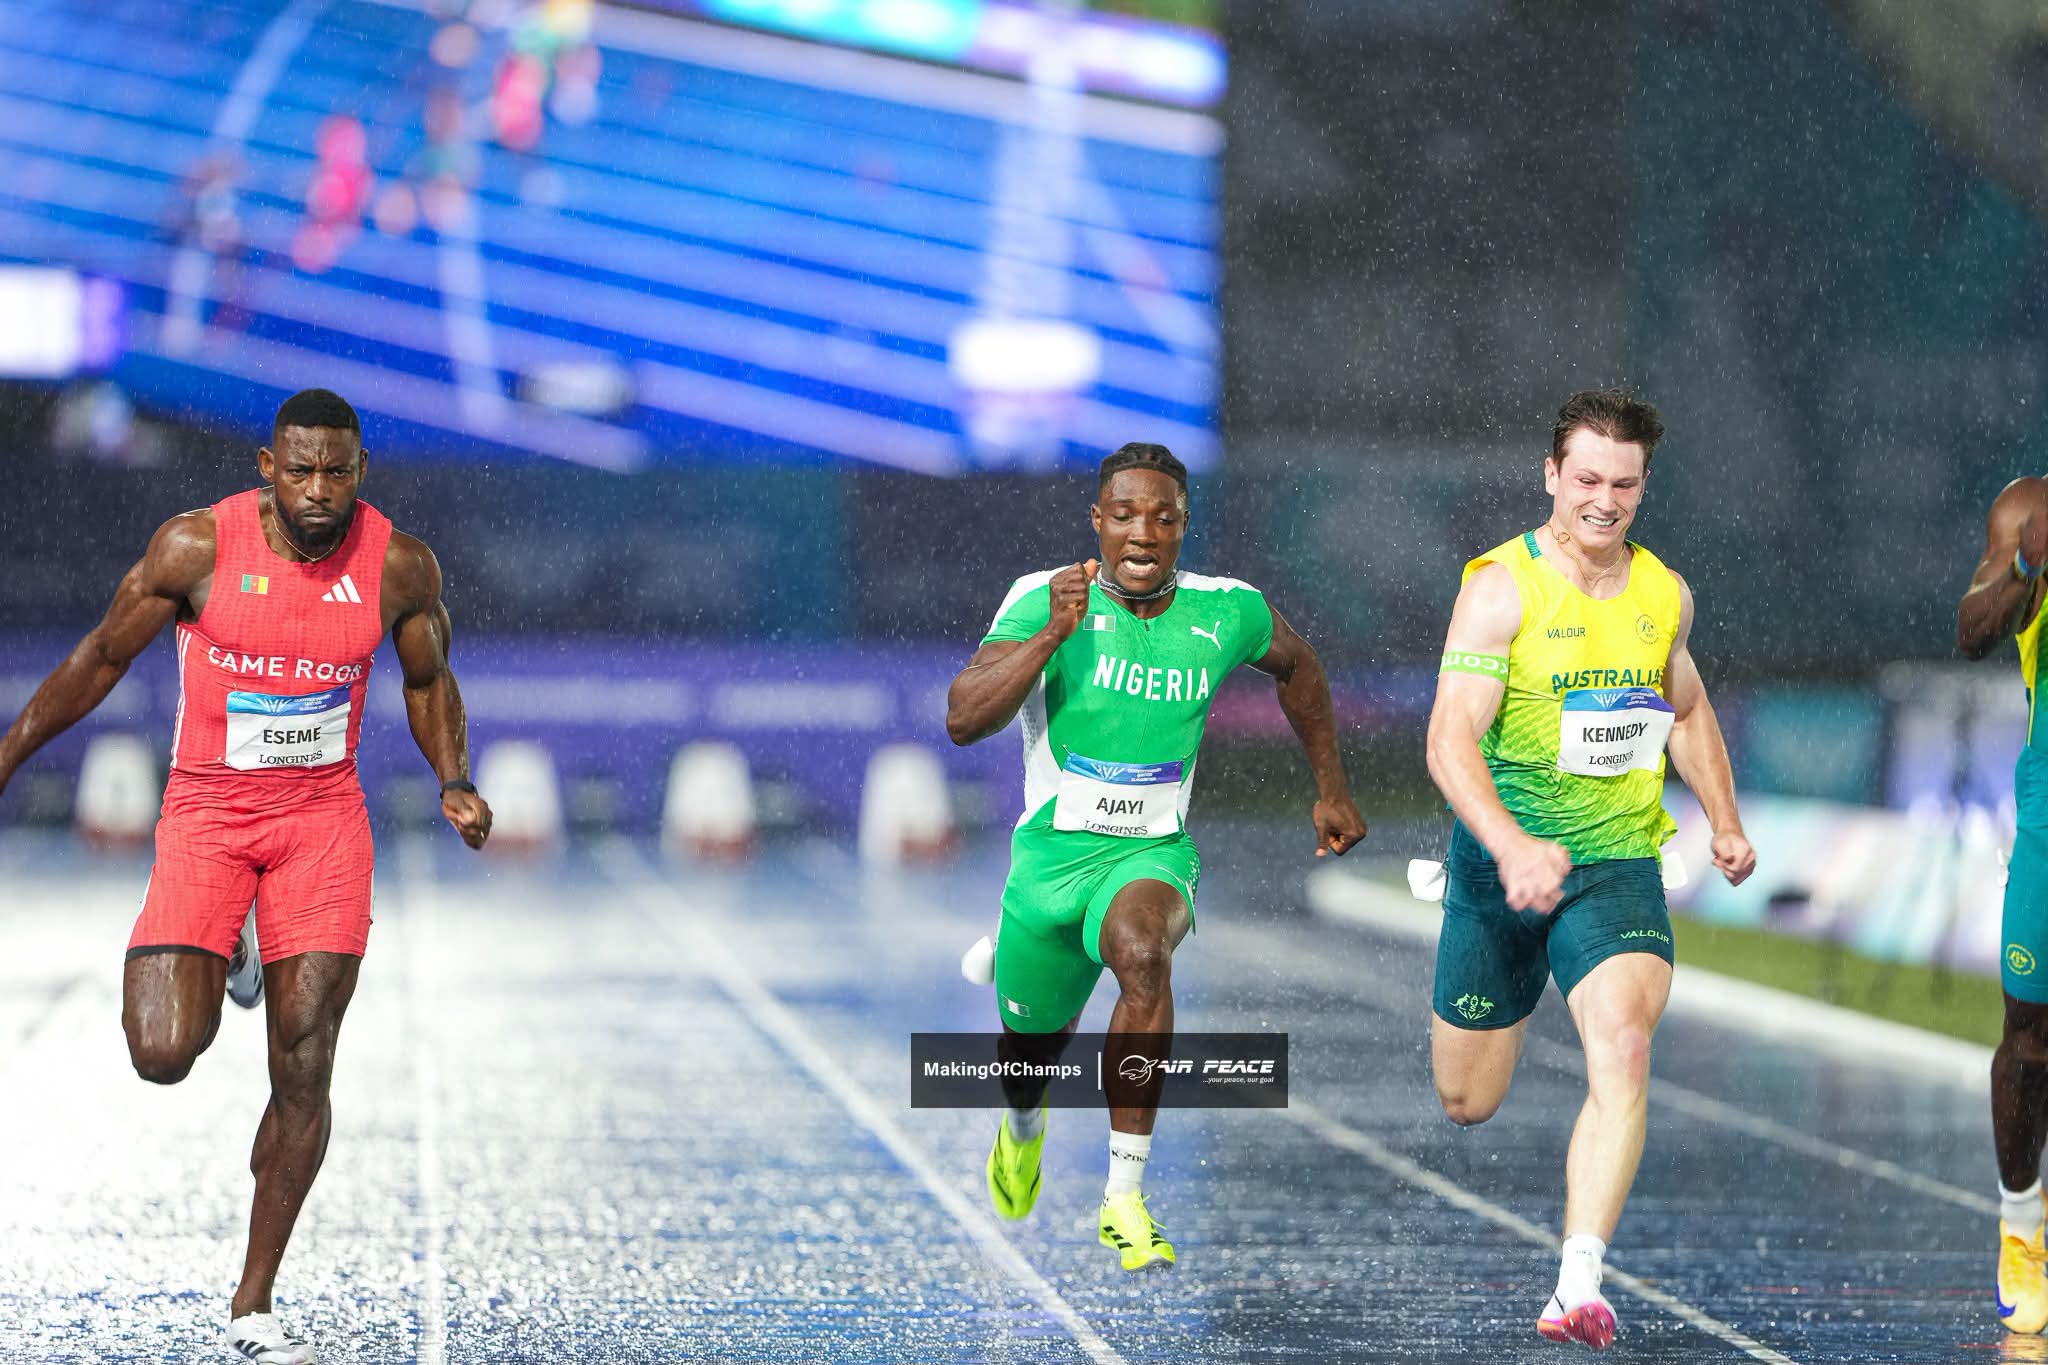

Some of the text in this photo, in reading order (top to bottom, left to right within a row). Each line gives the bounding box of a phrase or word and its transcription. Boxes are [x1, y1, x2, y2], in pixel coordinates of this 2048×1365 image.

[1547, 627, 1586, 639] VALOUR
[1093, 654, 1209, 702] NIGERIA
[1552, 669, 1661, 694] AUSTRALIA
[263, 727, 322, 745] ESEME
[1583, 722, 1648, 743] KENNEDY
[259, 750, 323, 765] LONGINES
[1096, 797, 1144, 815] AJAYI
[1084, 820, 1148, 836] LONGINES
[1620, 929, 1670, 944] VALOUR
